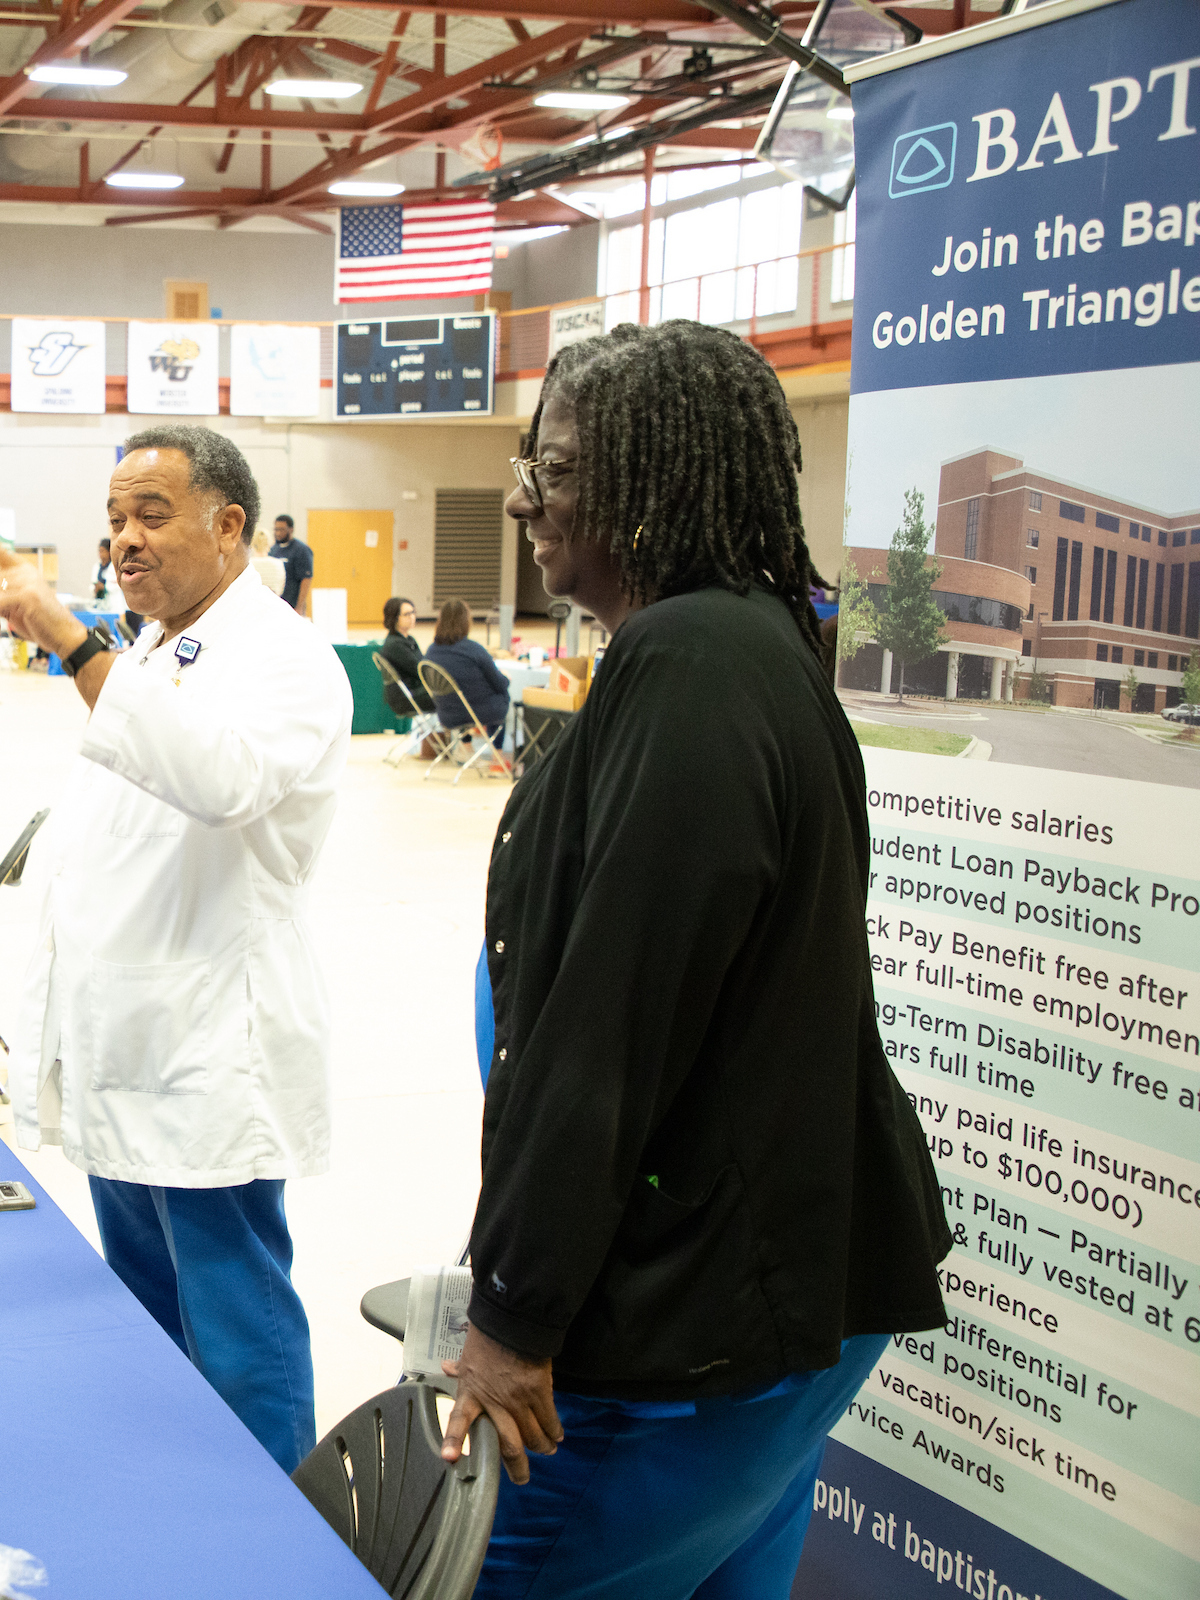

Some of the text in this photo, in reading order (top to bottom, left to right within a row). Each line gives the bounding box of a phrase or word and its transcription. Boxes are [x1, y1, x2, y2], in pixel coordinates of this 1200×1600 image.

[966, 58, 1200, 183] BAPT
[931, 200, 1200, 277] Join the Bap
[872, 268, 1200, 349] Golden Triangle
[868, 790, 1113, 845] ompetitive salaries
[872, 836, 1200, 916] udent Loan Payback Pro
[885, 876, 1005, 914] approved
[1015, 899, 1141, 944] positions
[866, 915, 1188, 1010] ck Pay Benefit free after
[871, 954, 1200, 1056] ear full-time employmen
[884, 1040, 1035, 1097] ars full time
[977, 1023, 1102, 1083] Disability
[1113, 1061, 1168, 1100] free
[924, 1133, 1143, 1228] up to $100,000)
[957, 1108, 1012, 1141] paid
[1023, 1123, 1062, 1158] life
[1073, 1140, 1200, 1209] insurance
[952, 1222, 968, 1247] &
[978, 1231, 1033, 1275] fully
[1043, 1260, 1134, 1315] vested
[1145, 1304, 1173, 1332] at
[973, 1193, 1027, 1234] Plan
[1070, 1229, 1188, 1300] Partially
[936, 1268, 1058, 1333] xperience
[943, 1353, 1062, 1424] positions
[944, 1316, 1137, 1421] differential for
[848, 1401, 1005, 1493] rvice Awards
[879, 1369, 1117, 1502] vacation/sick time
[813, 1478, 865, 1535] pply
[872, 1512, 897, 1550] at
